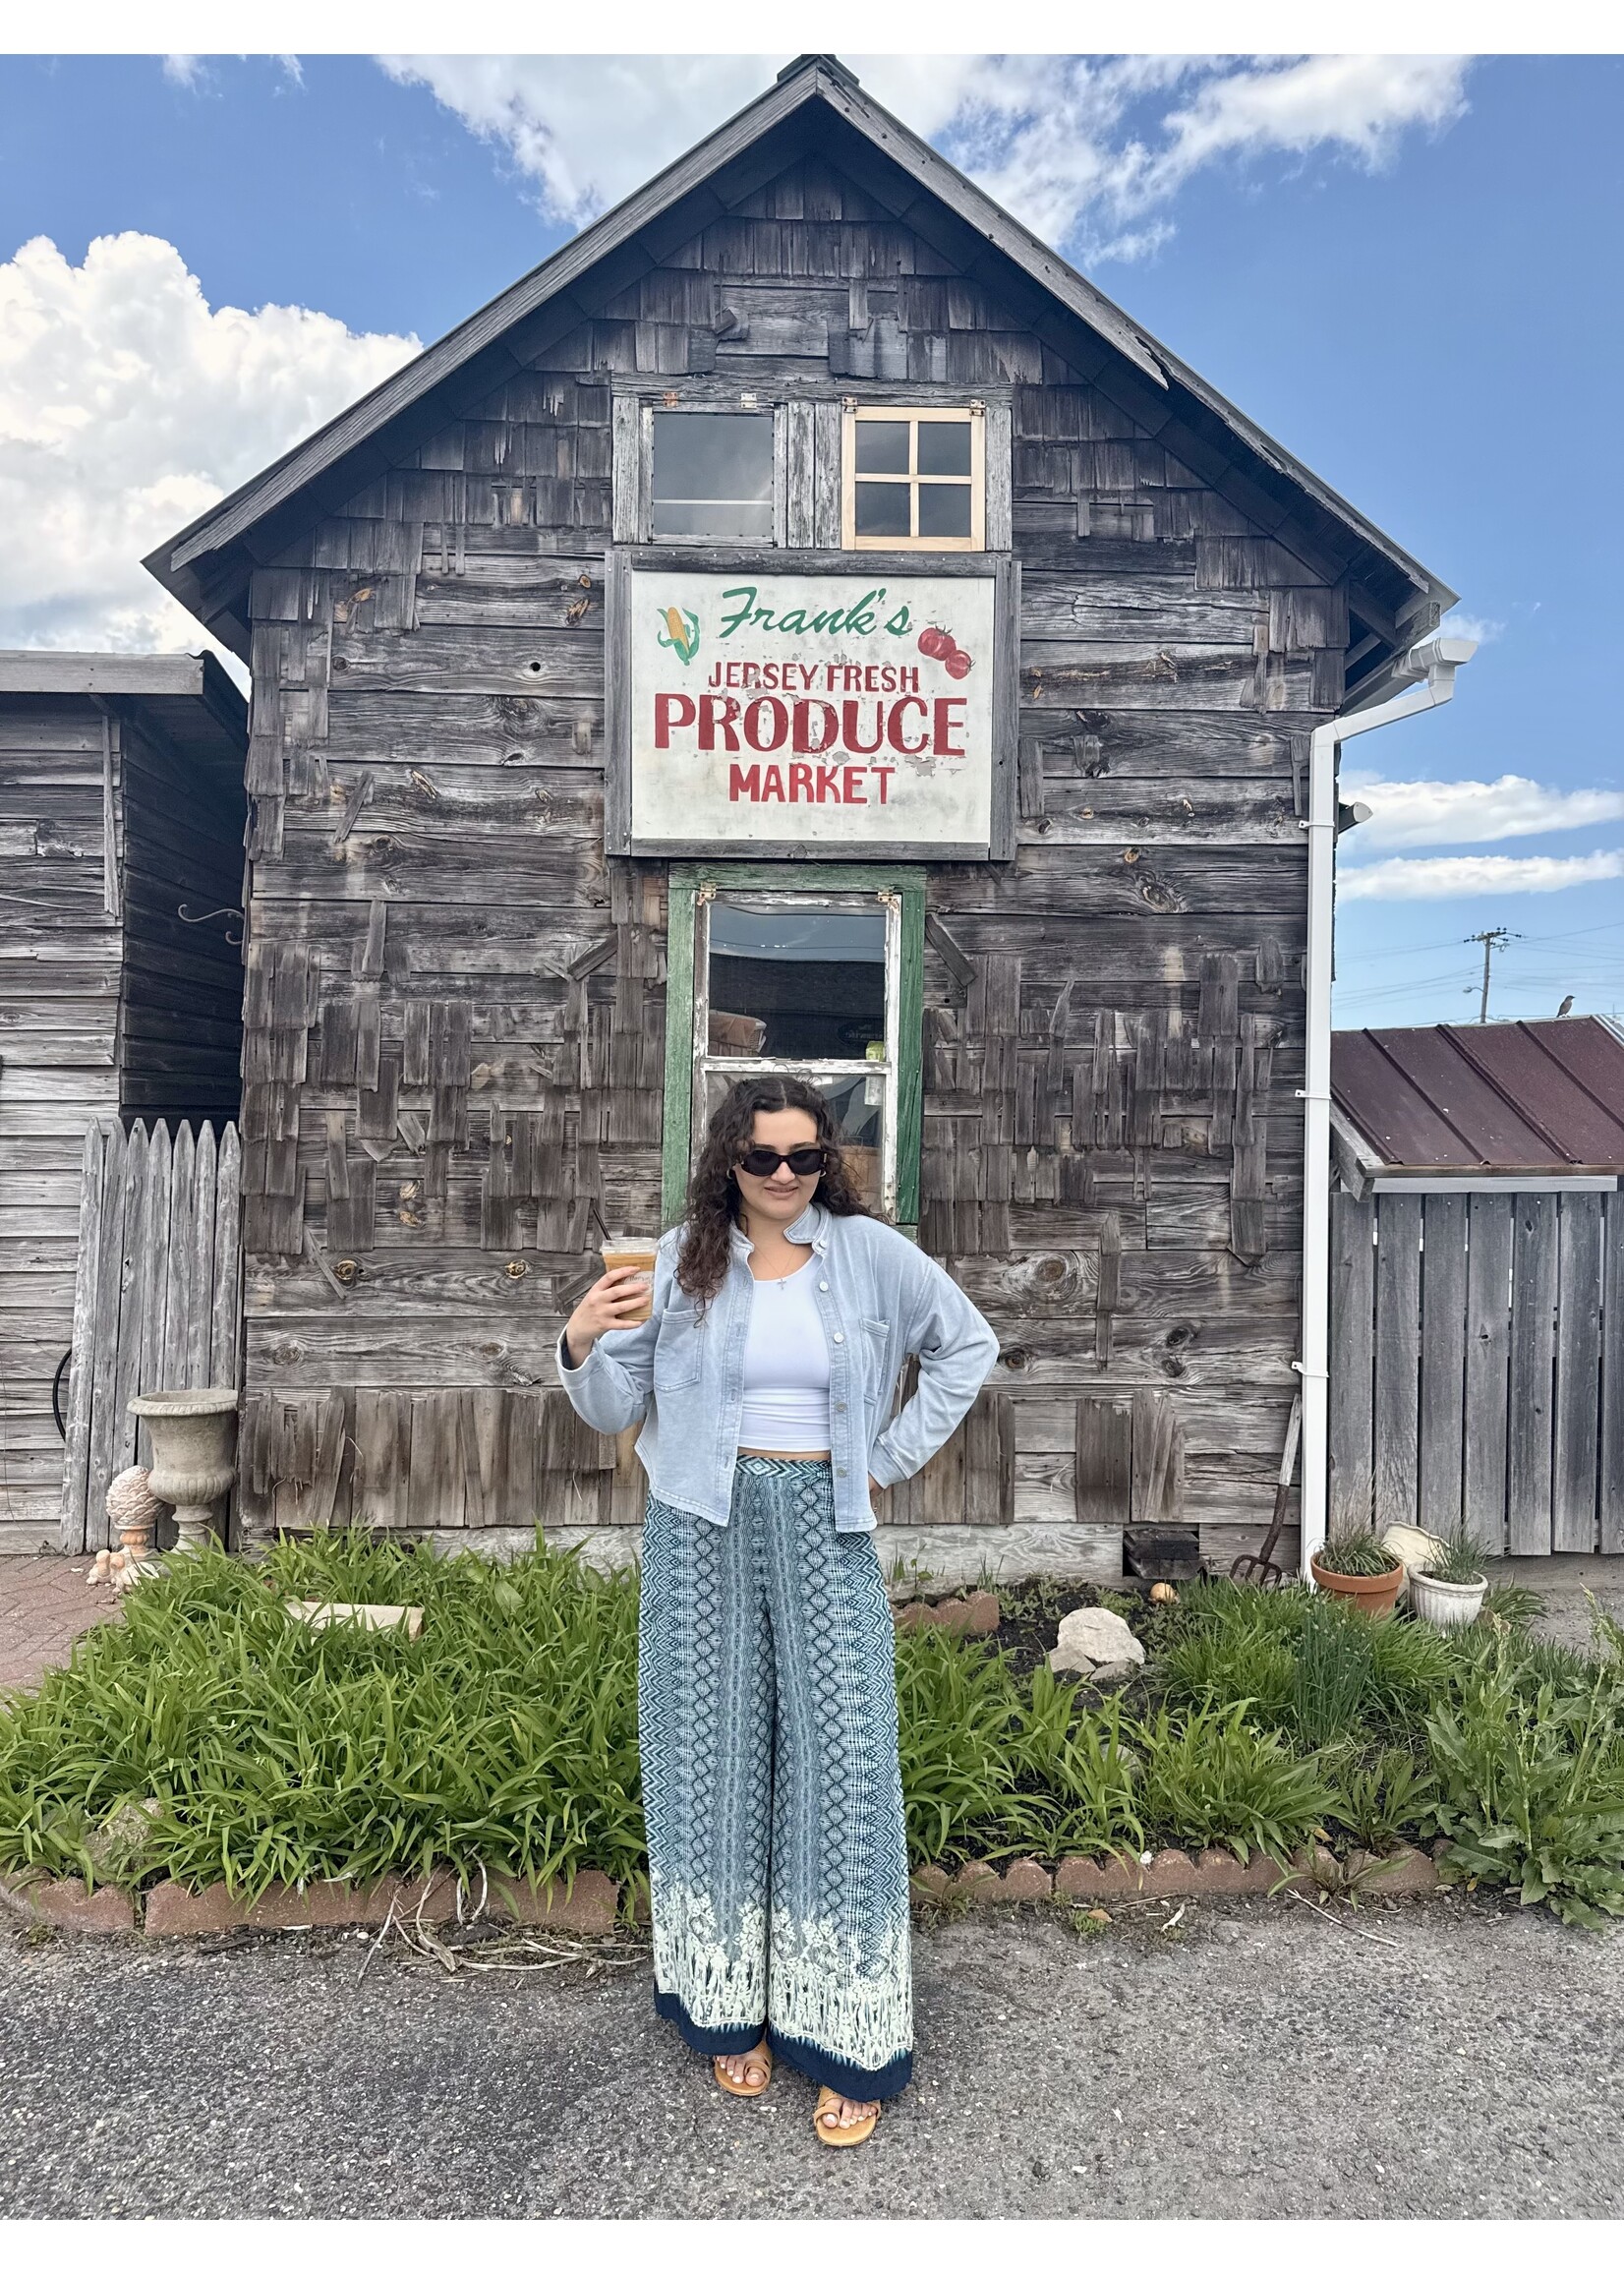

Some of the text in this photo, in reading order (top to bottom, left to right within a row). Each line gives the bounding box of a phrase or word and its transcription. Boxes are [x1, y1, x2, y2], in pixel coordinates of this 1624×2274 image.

[719, 586, 911, 638] Frank's
[708, 662, 919, 693] JERSEY FRESH
[655, 693, 968, 756] PRODUCE
[729, 763, 896, 804] MARKET
